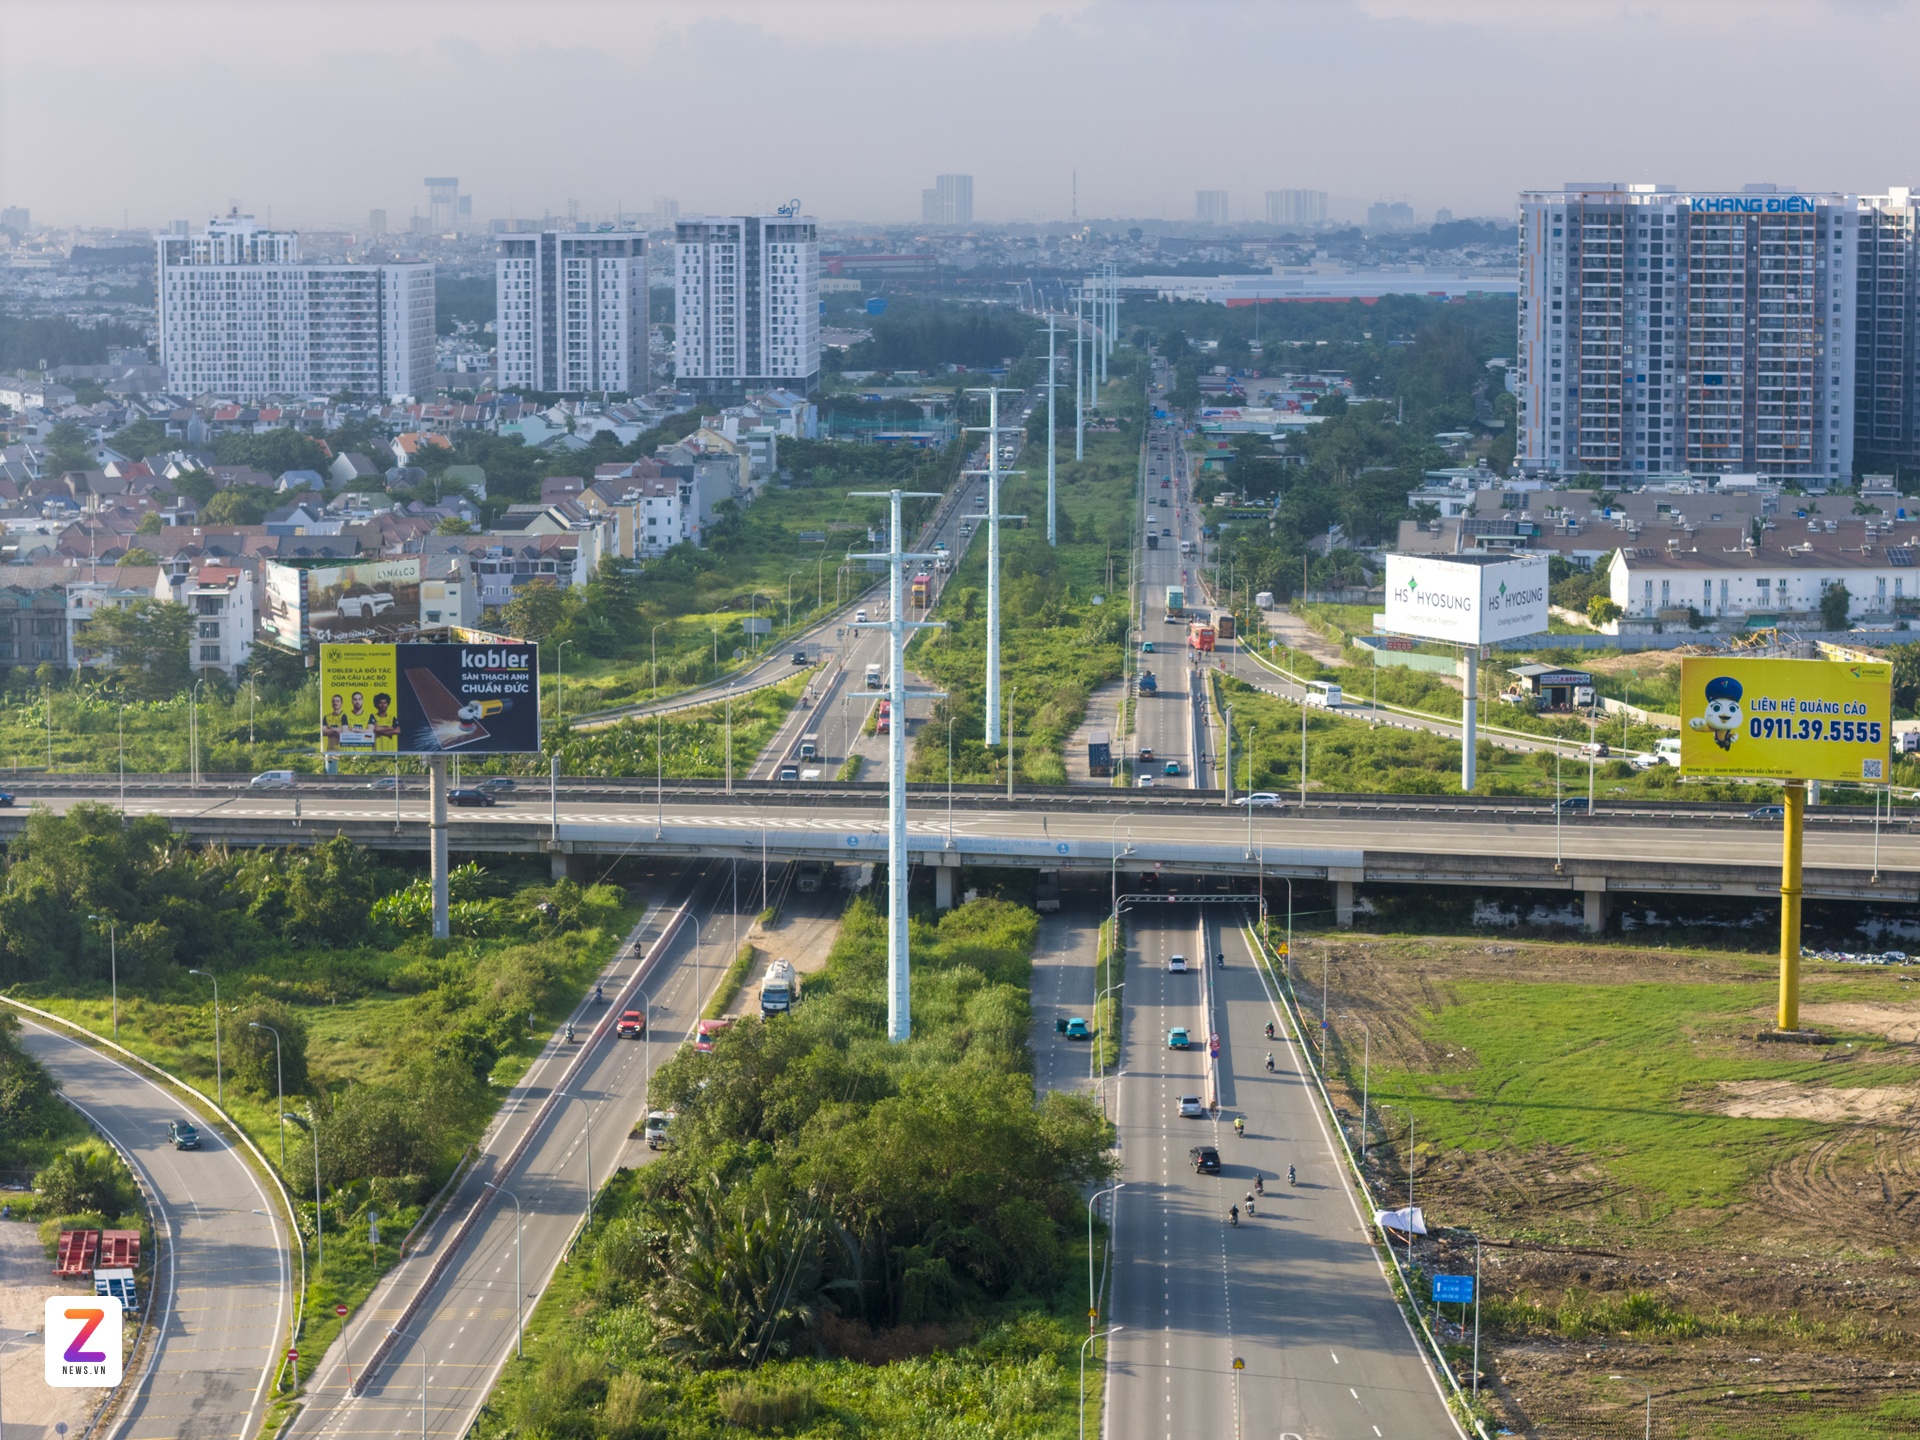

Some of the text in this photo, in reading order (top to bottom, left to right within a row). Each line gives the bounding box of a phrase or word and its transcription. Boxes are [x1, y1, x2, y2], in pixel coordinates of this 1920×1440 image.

[1691, 195, 1815, 213] KHANG ĐIỀN
[1394, 587, 1471, 611] HS HYOSUNG
[1489, 587, 1543, 611] HS HYOSUNG
[328, 649, 341, 659] BVB
[461, 649, 529, 668] kobler
[378, 666, 391, 674] TÁC
[461, 672, 479, 680] SÀN
[480, 673, 509, 682] THẠCH
[461, 681, 529, 693] CHUẨN ĐỨC
[1750, 696, 1867, 715] LIÊN HỆ QUẢNG CÁO
[1749, 717, 1881, 743] 0911.39.5555
